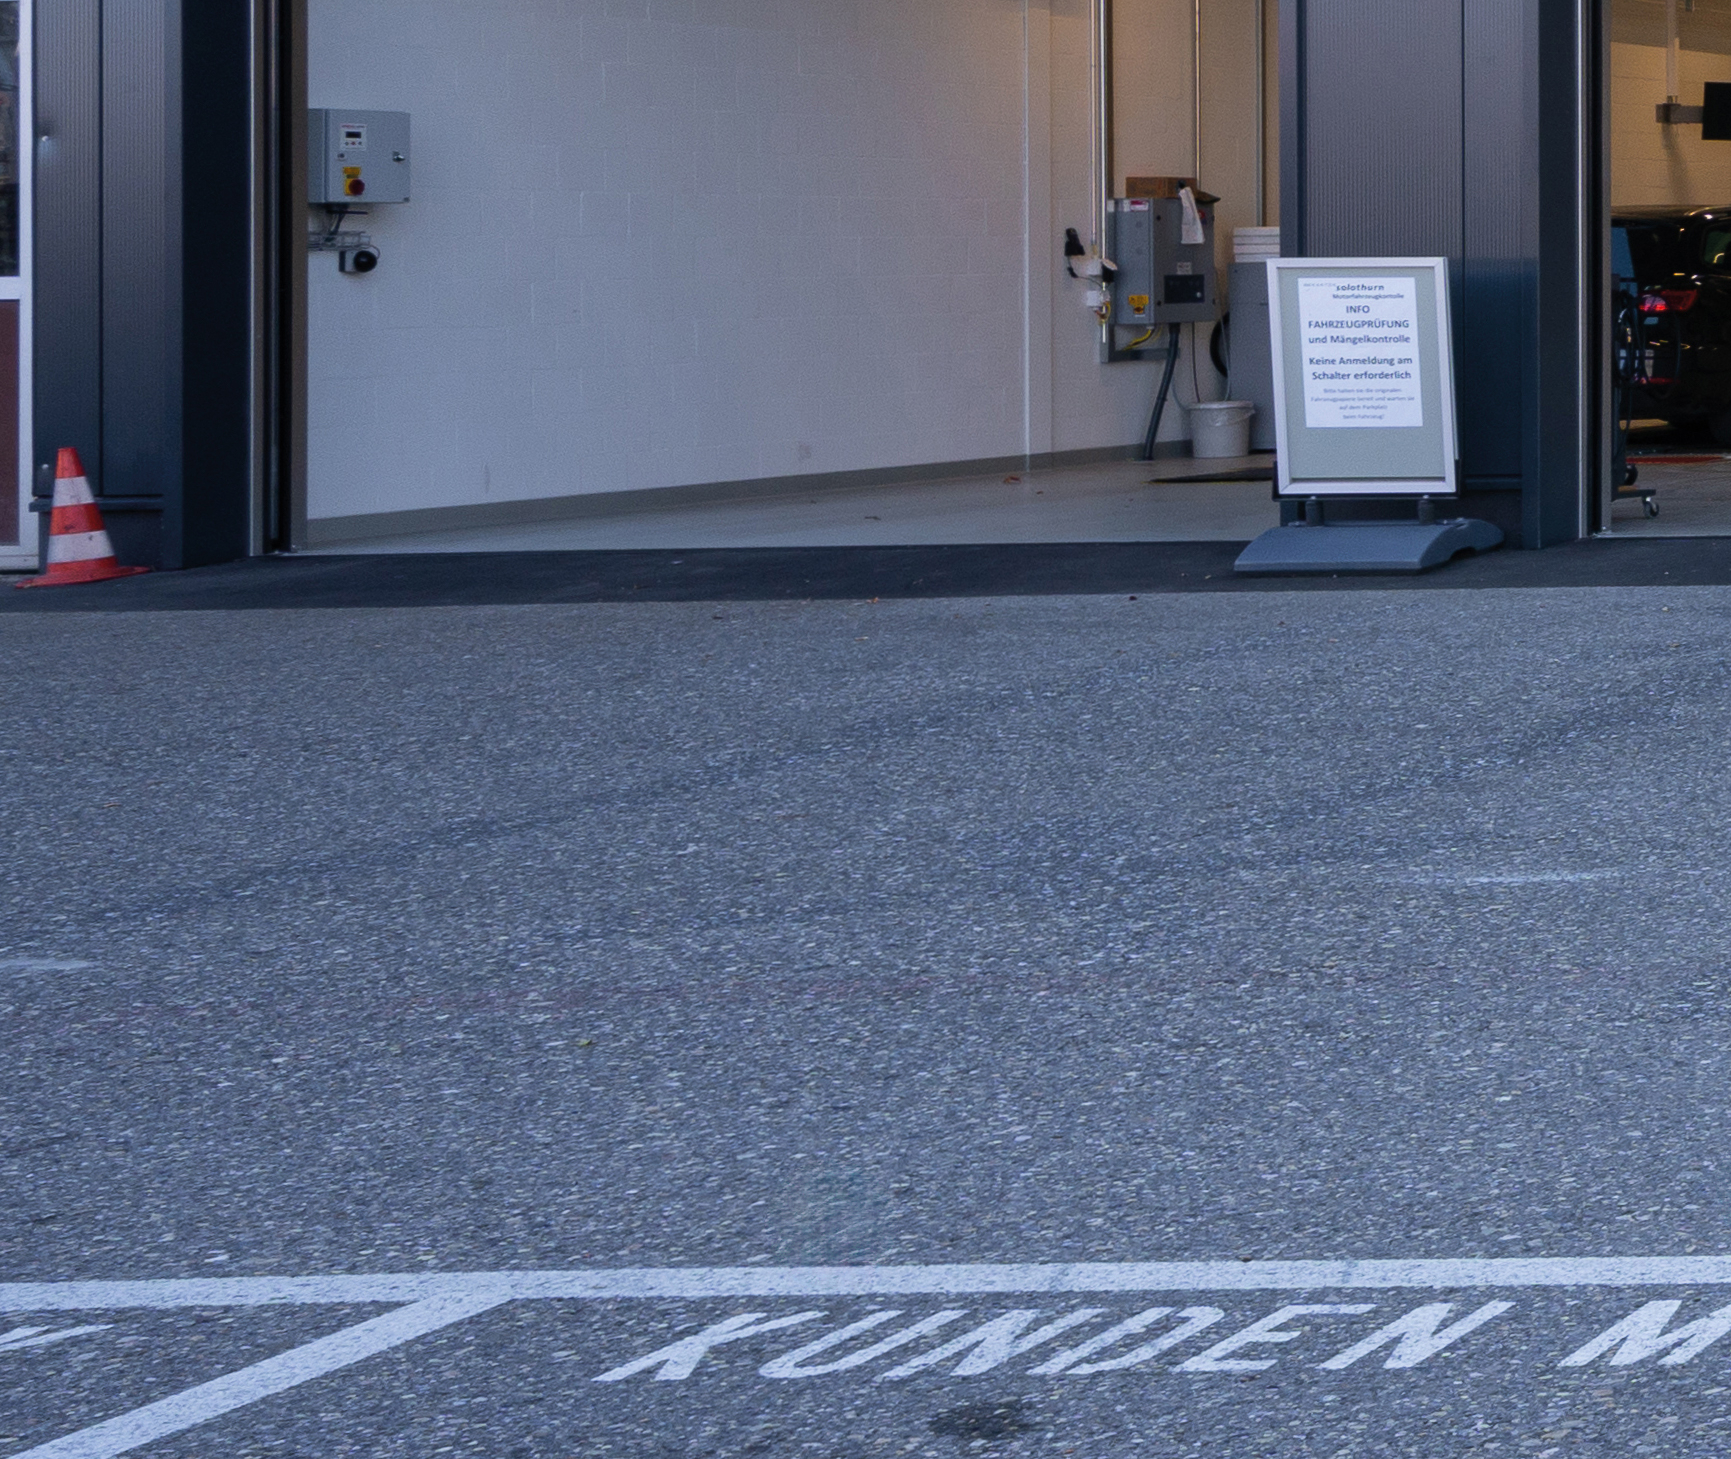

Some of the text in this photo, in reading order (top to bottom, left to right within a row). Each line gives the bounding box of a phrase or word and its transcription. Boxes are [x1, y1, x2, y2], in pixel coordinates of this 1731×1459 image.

[1336, 283, 1385, 292] solothurn
[1346, 305, 1371, 314] INFO
[1307, 318, 1410, 329] FAHRZEUGPRÜFUNG
[1308, 335, 1411, 346] und Mängelkontrolle
[1308, 356, 1413, 367] Keine Anmeldung am
[1312, 370, 1412, 380] Schalter erforderlich
[592, 1301, 1517, 1382] KUNDEN
